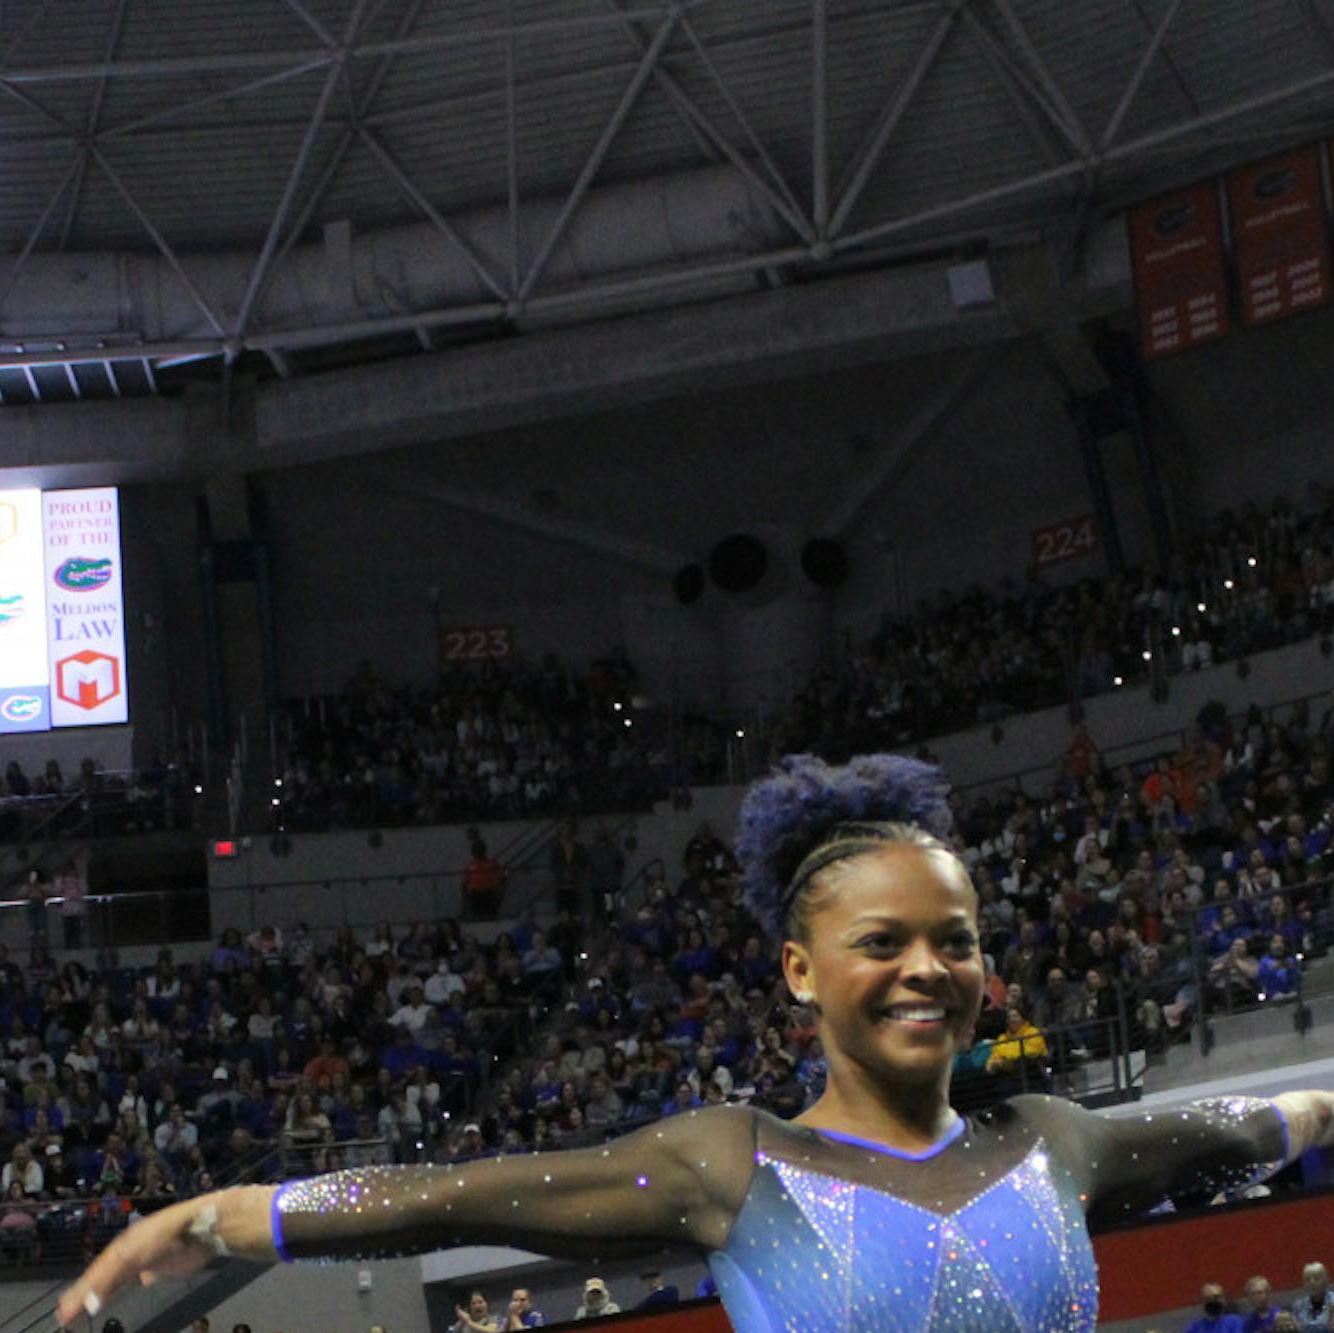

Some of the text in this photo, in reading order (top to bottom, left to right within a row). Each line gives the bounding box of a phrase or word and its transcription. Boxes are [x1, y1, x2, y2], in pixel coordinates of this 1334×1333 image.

[49, 500, 112, 515] PROUD
[50, 530, 113, 546] OF THE
[1035, 519, 1096, 562] 224
[52, 602, 117, 617] MELDON
[53, 617, 117, 641] LAW
[445, 628, 509, 660] 223
